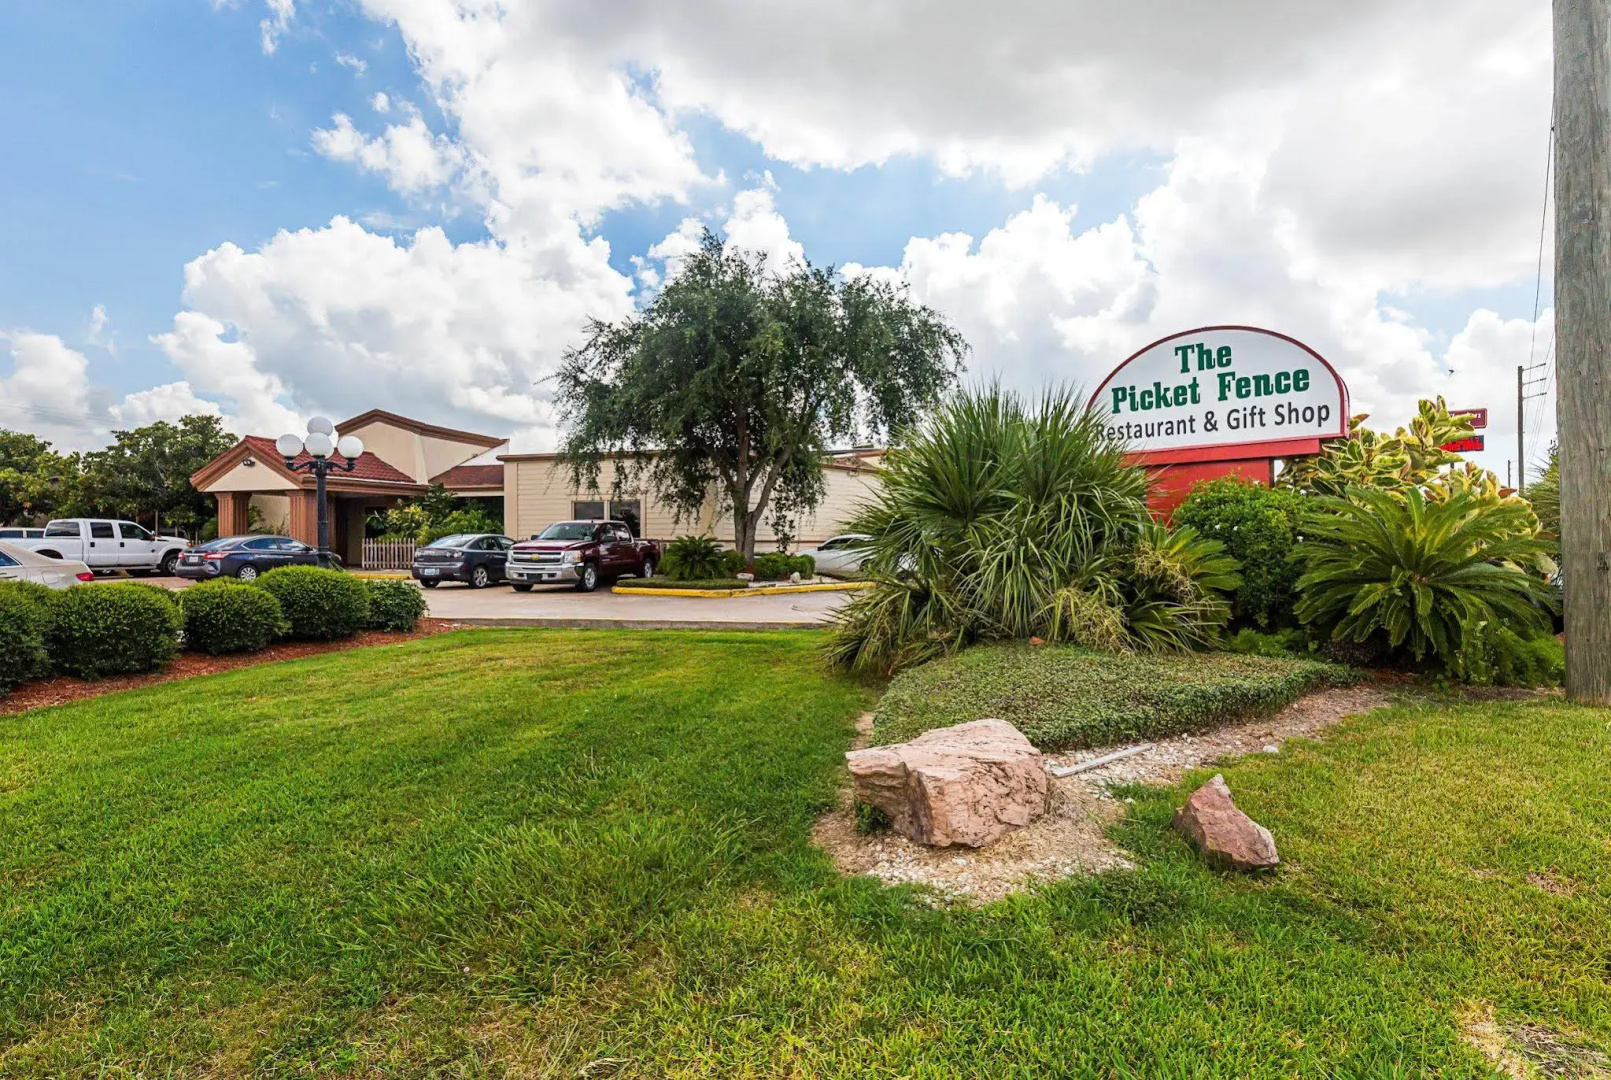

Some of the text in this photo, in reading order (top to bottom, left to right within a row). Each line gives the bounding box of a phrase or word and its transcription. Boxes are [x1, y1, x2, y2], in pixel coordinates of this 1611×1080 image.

[1174, 342, 1232, 374] The
[1111, 369, 1310, 414] Picket Fence
[1096, 402, 1330, 441] Restaurant & Gift Shop
